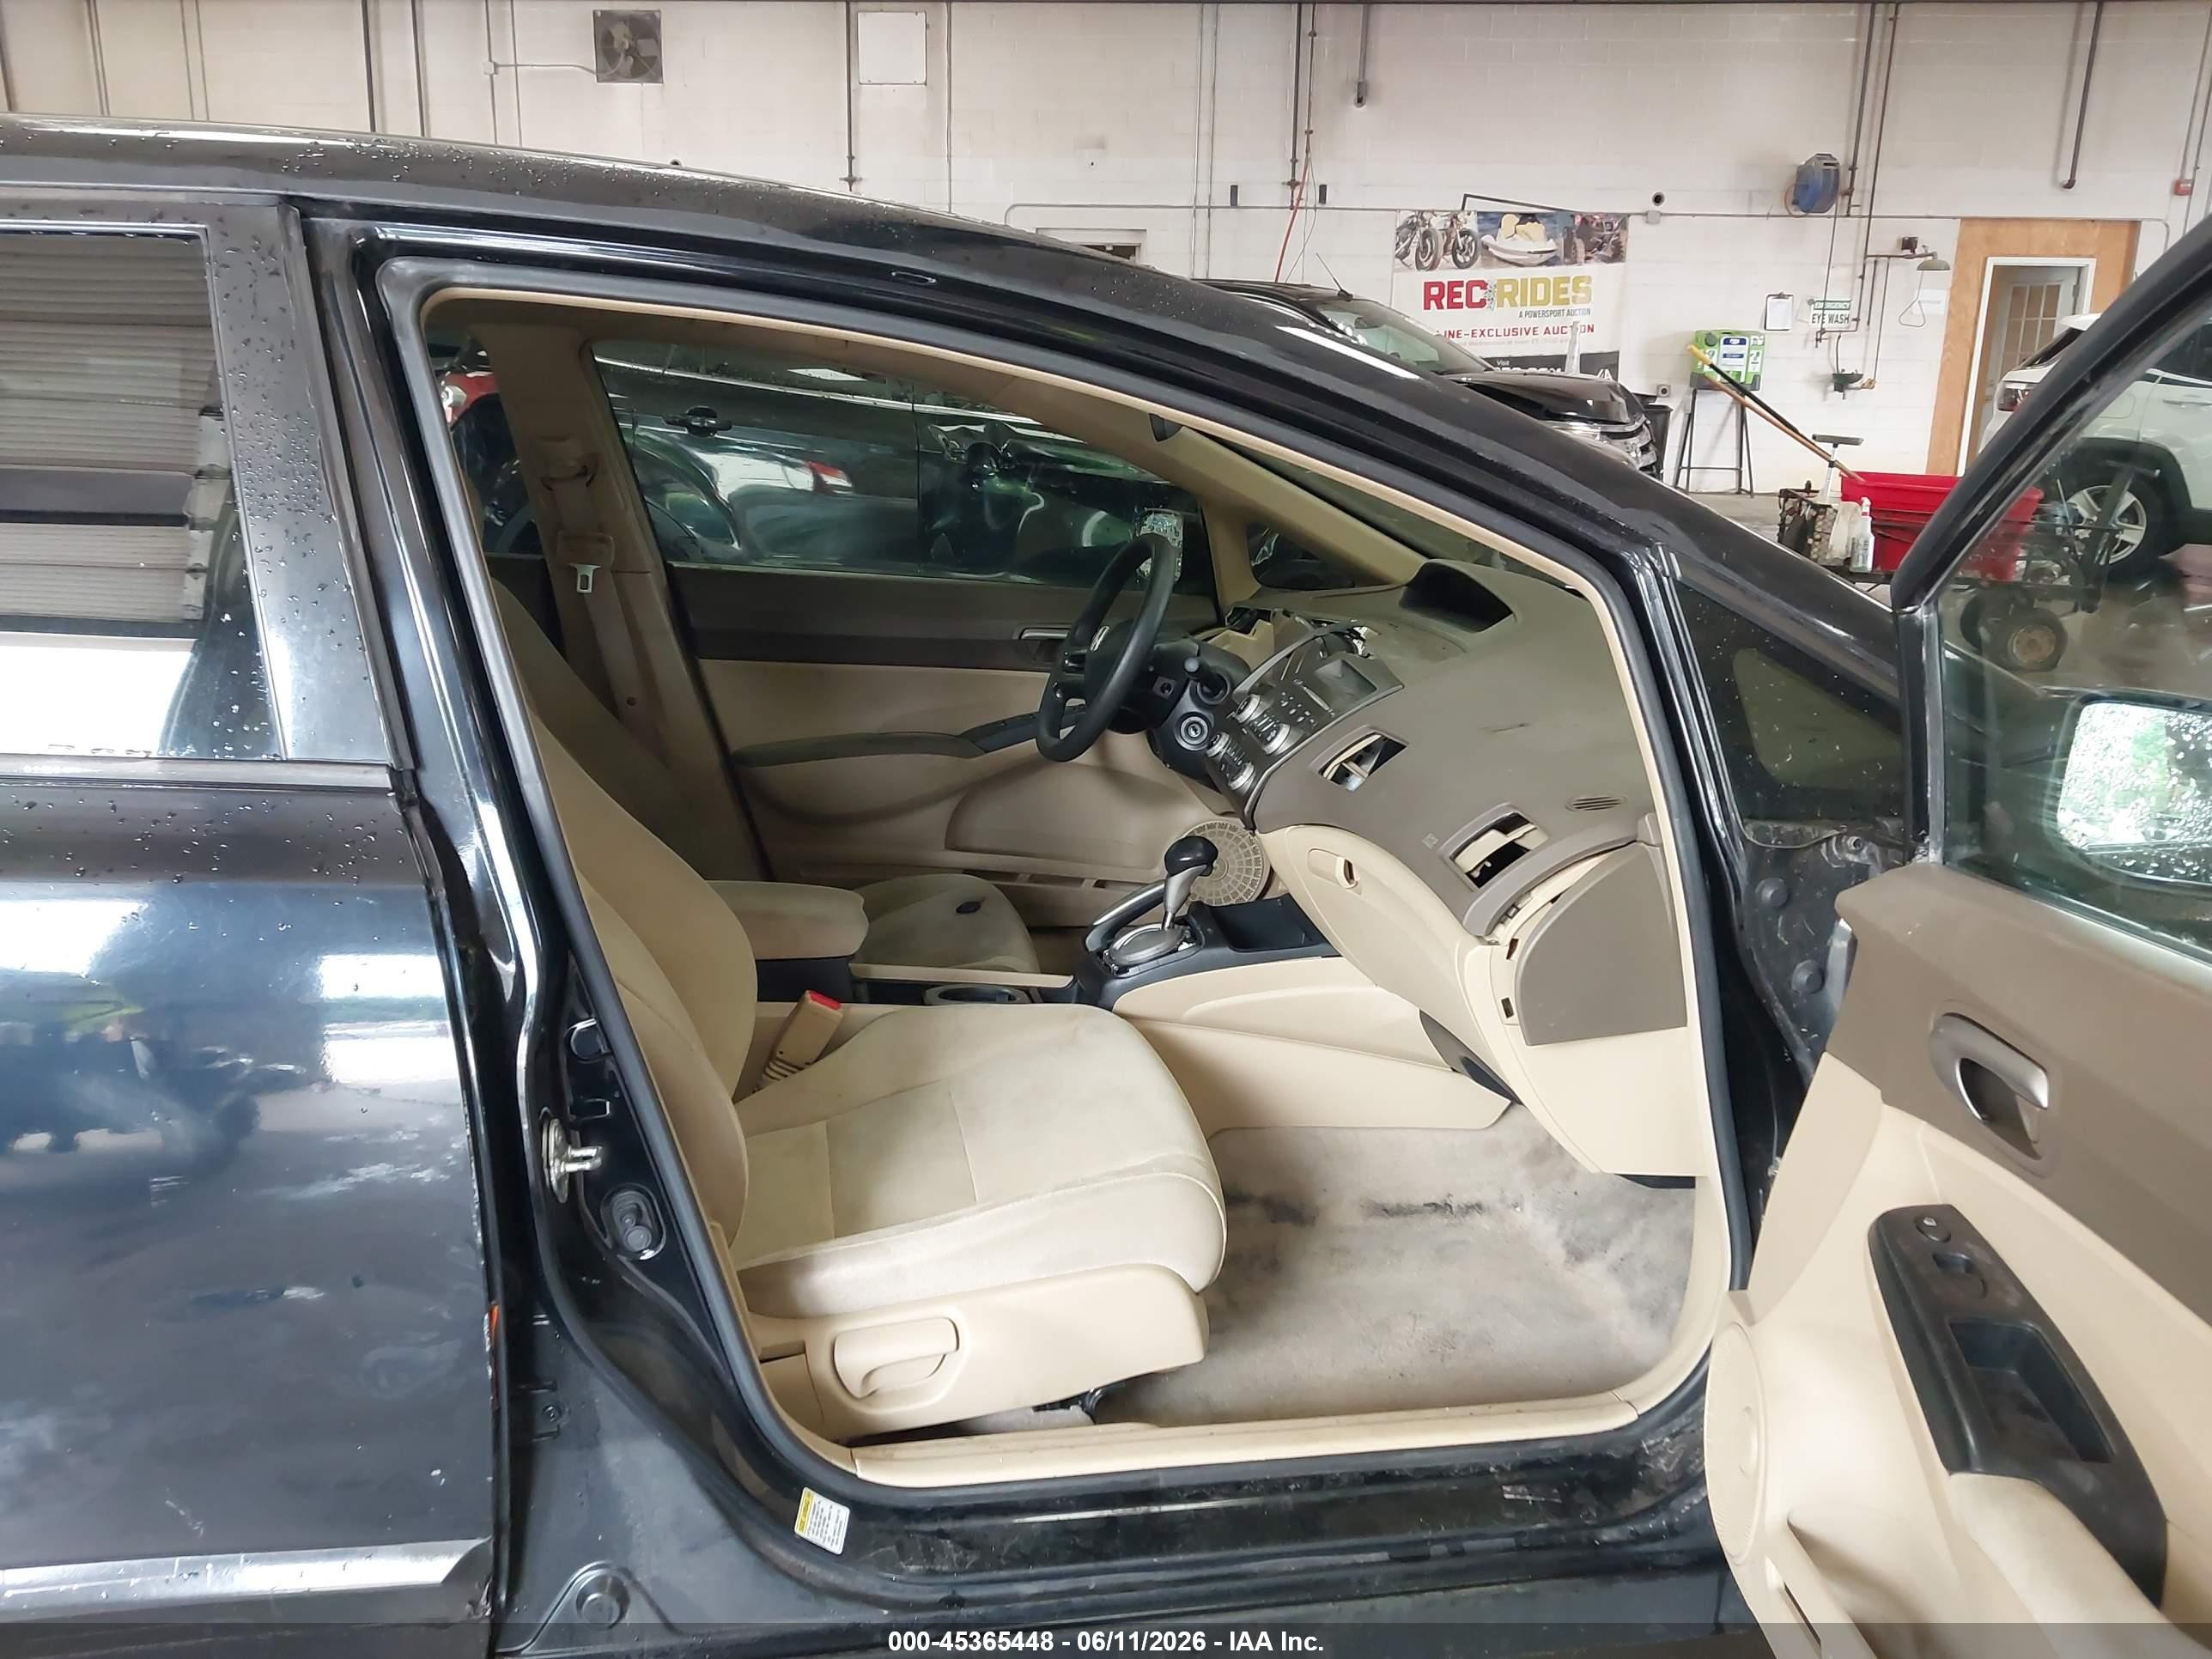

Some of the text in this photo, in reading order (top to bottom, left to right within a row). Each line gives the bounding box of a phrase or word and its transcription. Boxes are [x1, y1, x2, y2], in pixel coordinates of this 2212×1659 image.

[1423, 275, 1593, 311] REC RIDES
[1518, 307, 1591, 319] A POWERSPORT AUCTION
[1812, 313, 1850, 324] EYE WASH
